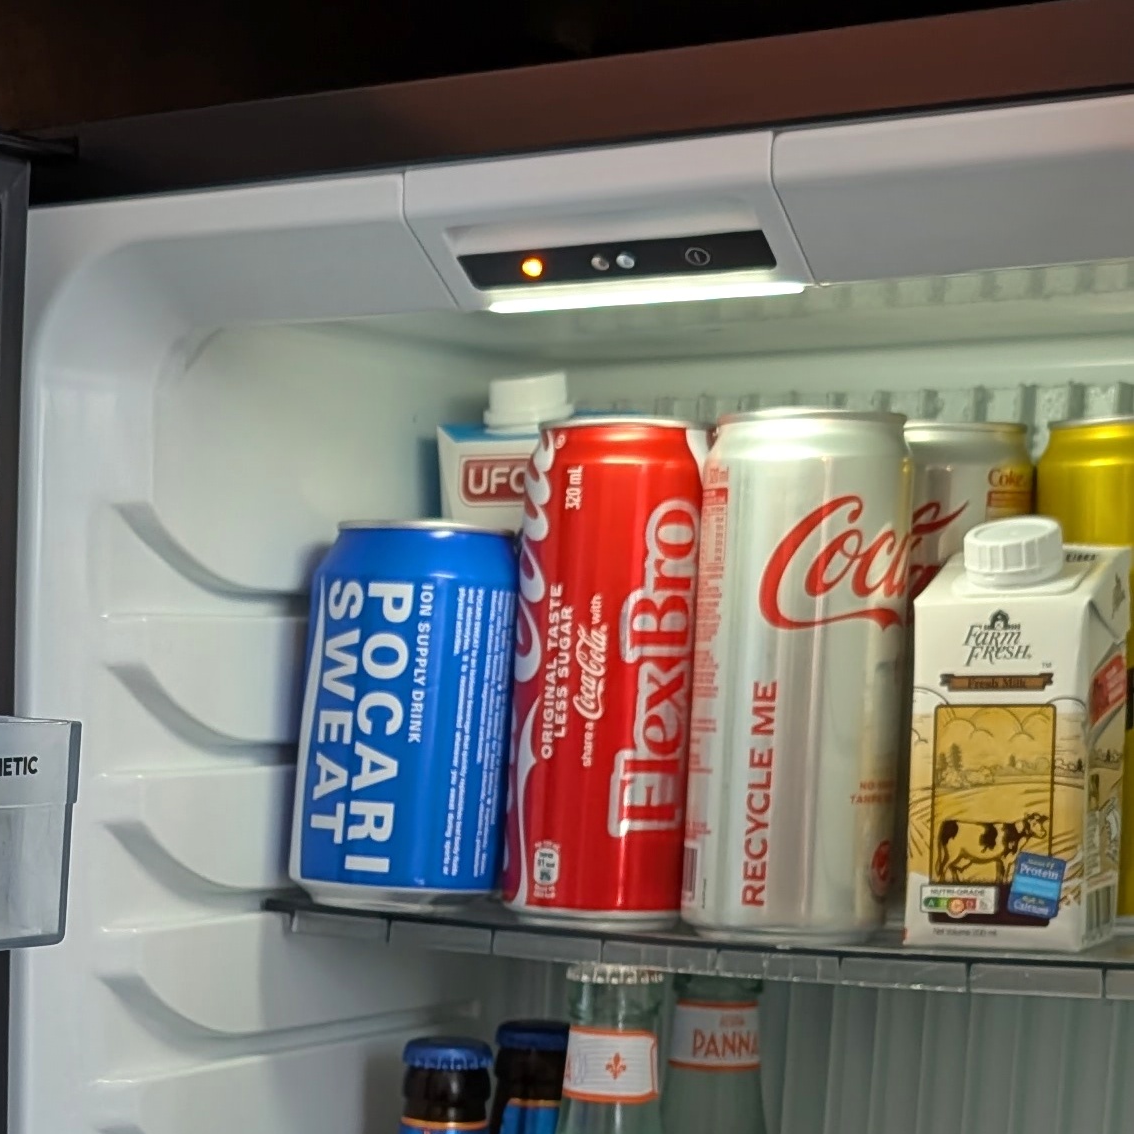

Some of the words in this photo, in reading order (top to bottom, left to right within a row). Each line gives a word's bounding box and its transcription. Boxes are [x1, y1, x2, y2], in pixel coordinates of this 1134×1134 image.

[565, 488, 582, 510] 320
[419, 583, 434, 616] ION
[547, 583, 563, 651] TASTE
[589, 593, 602, 625] with
[413, 621, 432, 686] SUPPLY
[557, 606, 573, 678] SUGAR
[607, 499, 698, 837] FlexBro
[309, 580, 365, 844] SWEAT
[344, 582, 414, 873] POCARI
[407, 689, 426, 744] DRINK
[541, 657, 557, 760] ORIGINAL
[554, 685, 568, 738] LESS
[750, 681, 777, 736] ME
[741, 747, 773, 907] RECYCLE
[1019, 863, 1059, 880] Protein
